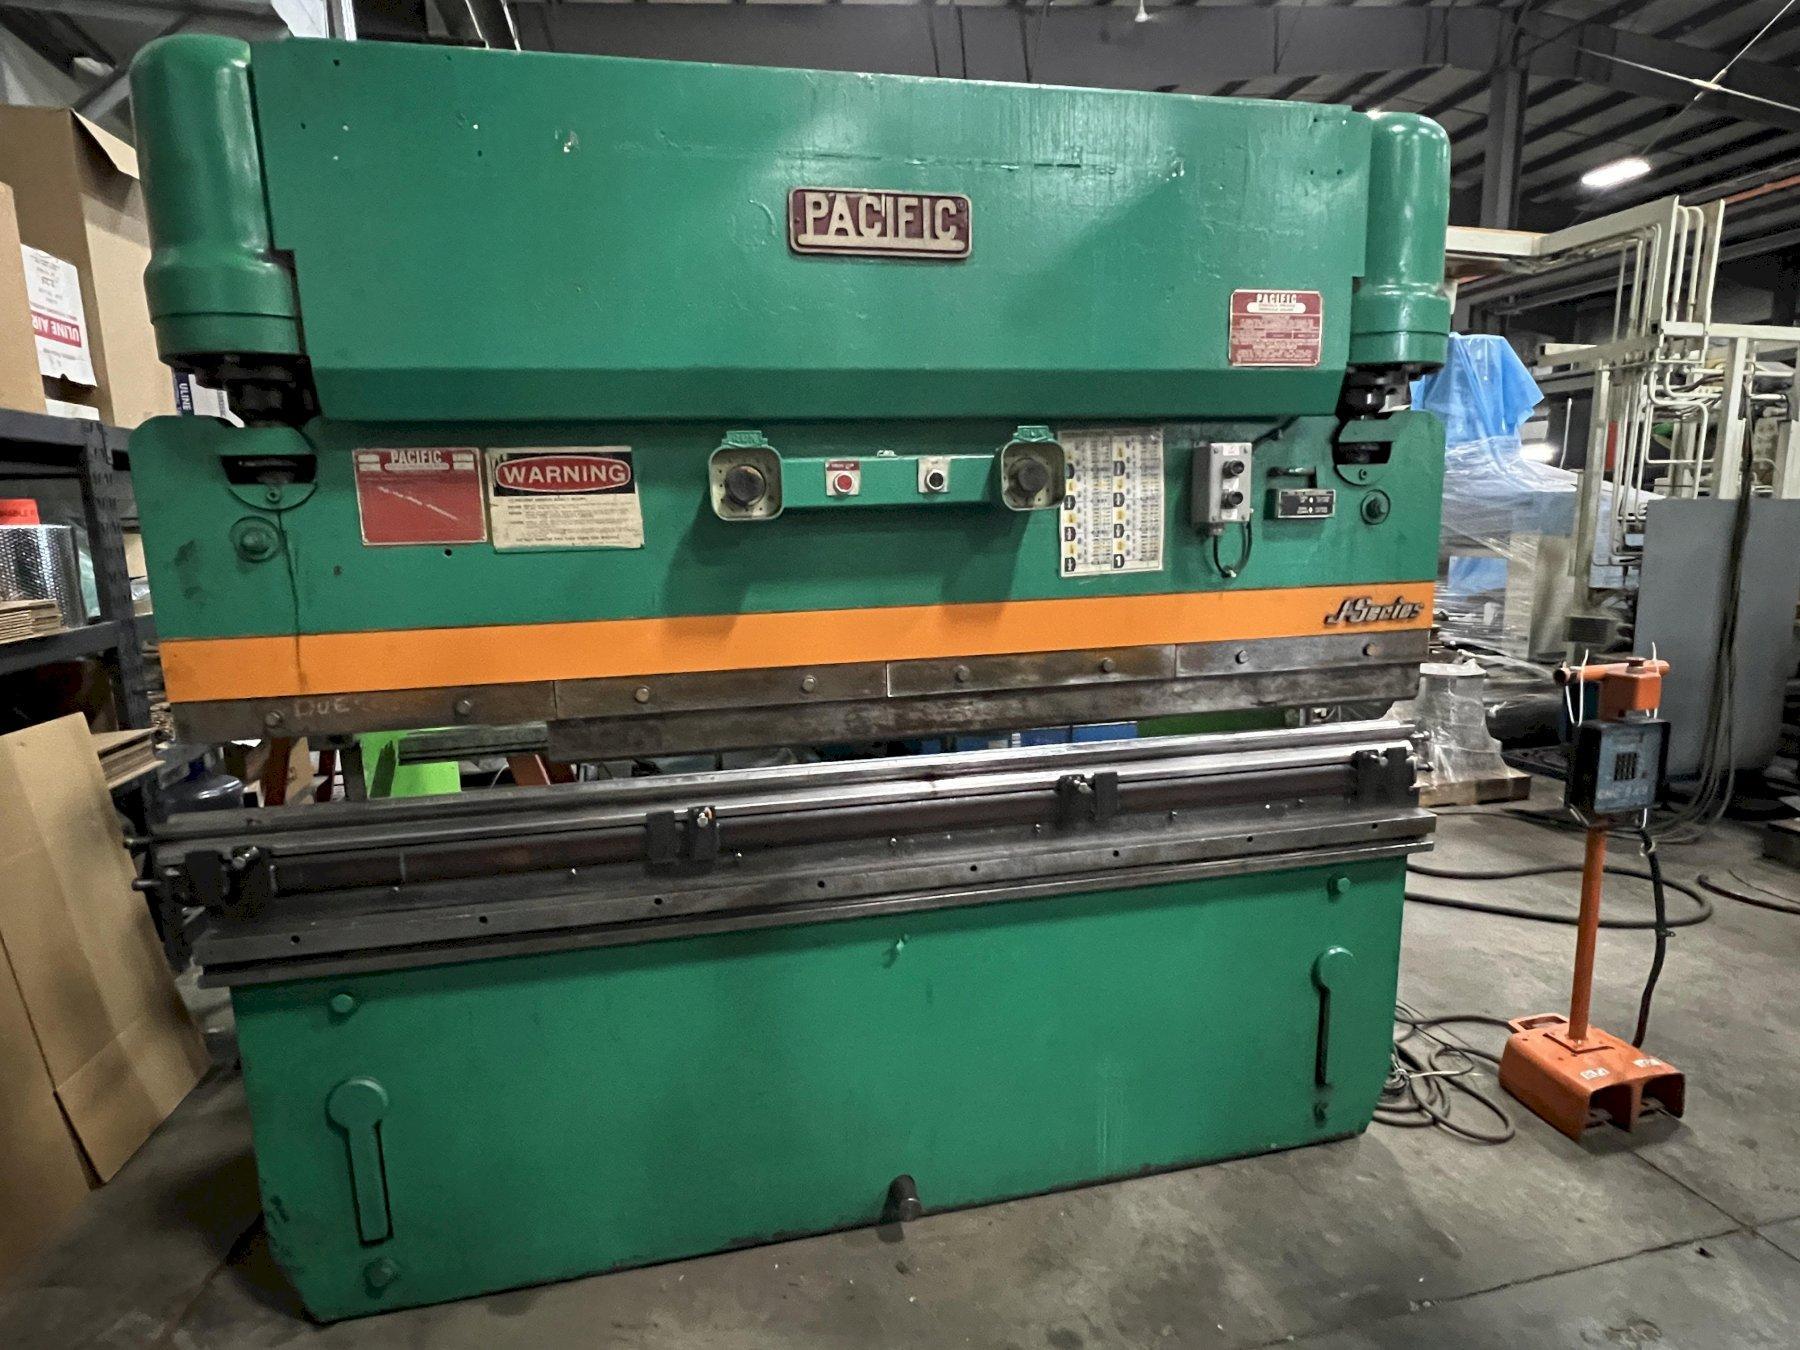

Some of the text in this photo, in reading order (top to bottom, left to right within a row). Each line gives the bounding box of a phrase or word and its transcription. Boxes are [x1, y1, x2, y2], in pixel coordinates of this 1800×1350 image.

[804, 192, 957, 241] PACIFIC
[1256, 293, 1297, 303] PACIFIC
[51, 321, 80, 343] ULINE
[179, 382, 192, 411] ULINE
[390, 450, 443, 464] PACIFIC
[502, 463, 626, 484] WARNING
